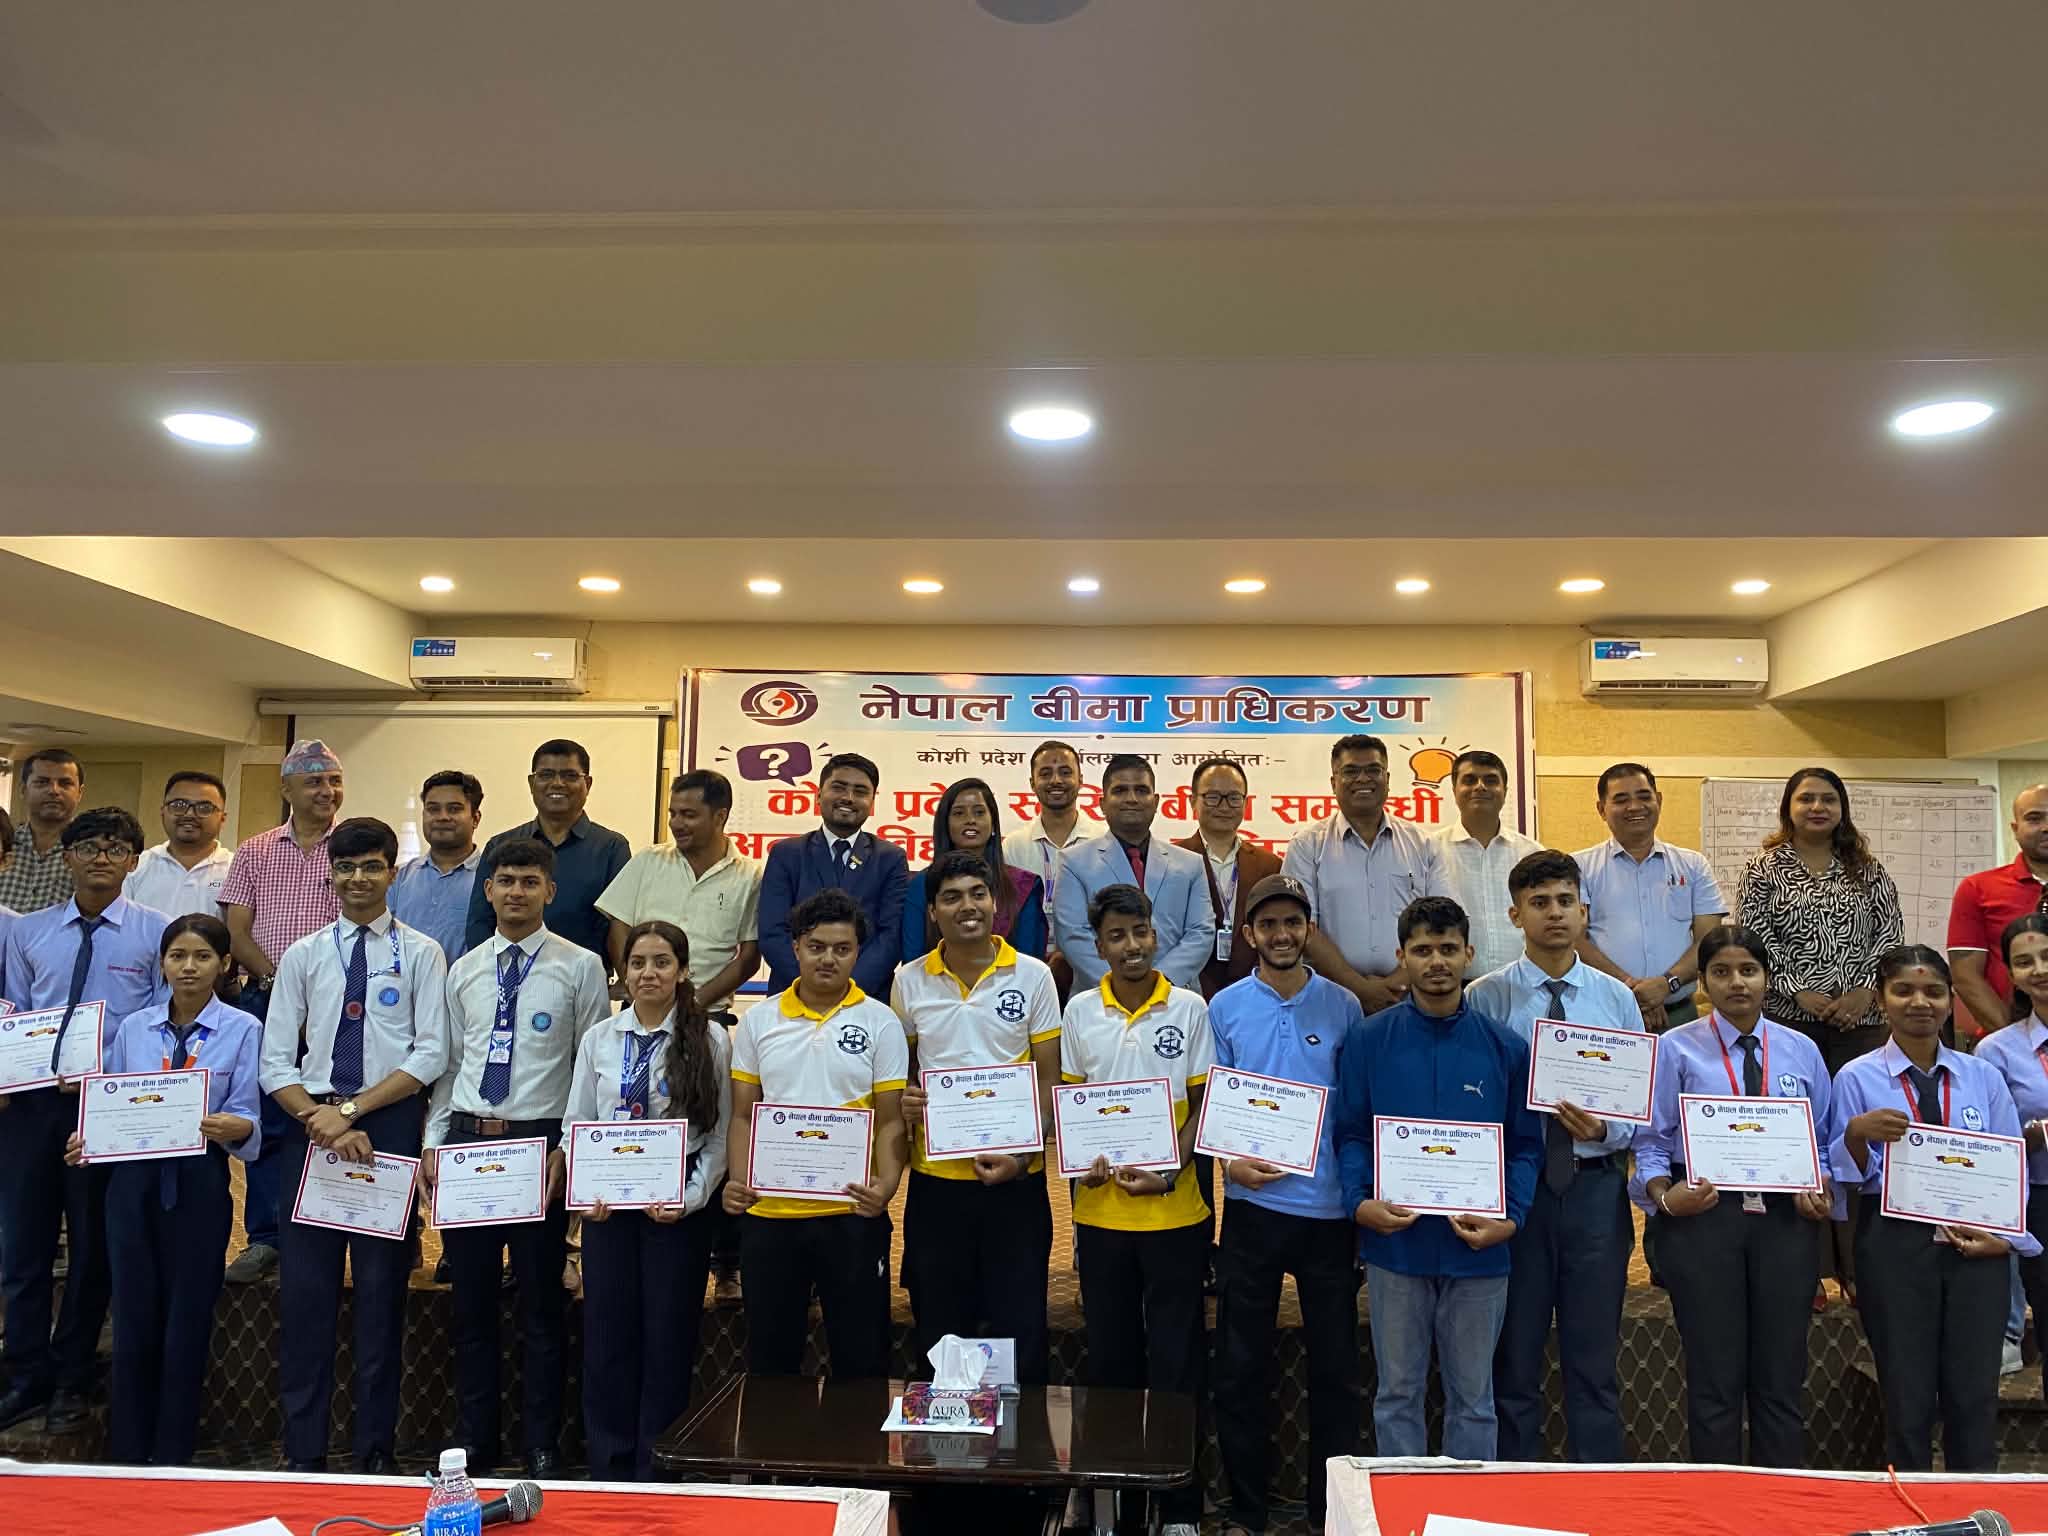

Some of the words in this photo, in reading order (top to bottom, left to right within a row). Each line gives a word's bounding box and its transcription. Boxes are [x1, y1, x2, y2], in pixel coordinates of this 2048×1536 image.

[860, 683, 1013, 722] नेपाल
[1031, 684, 1149, 723] बीमा
[1166, 686, 1431, 728] प्राधिकरण
[917, 747, 971, 765] कोशी
[980, 748, 1026, 765] प्रदेश
[932, 1405, 965, 1417] AURA
